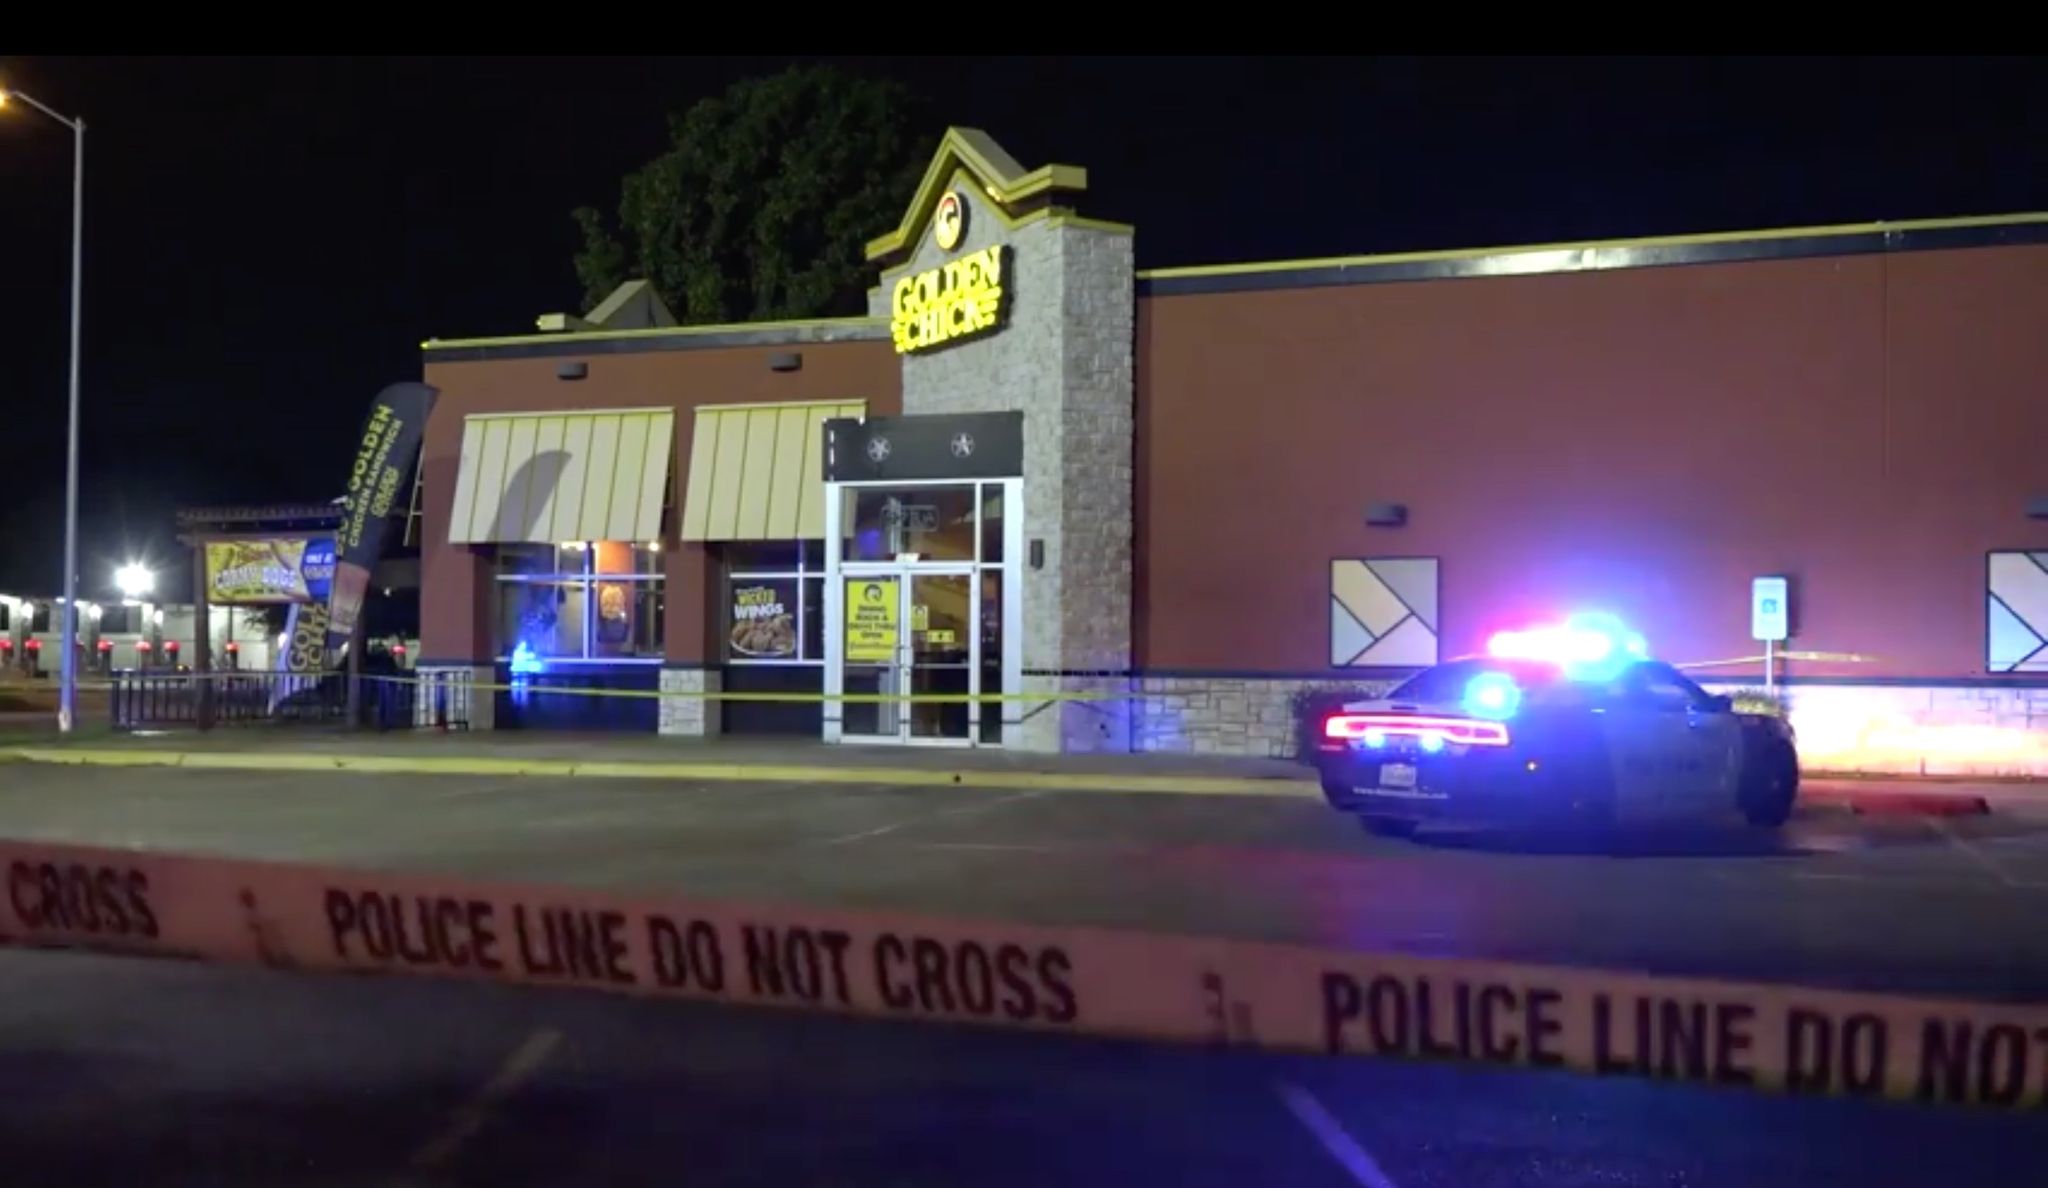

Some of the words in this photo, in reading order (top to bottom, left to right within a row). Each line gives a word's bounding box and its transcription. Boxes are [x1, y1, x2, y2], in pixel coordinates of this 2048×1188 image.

[893, 245, 1000, 319] GOLDEN
[903, 299, 985, 351] CHICK
[348, 403, 394, 491] GOLDEN
[349, 488, 371, 547] CHICKEN
[366, 419, 403, 486] SANDWICH
[734, 603, 784, 619] WINGS
[8, 861, 159, 938] CROSS
[324, 888, 505, 969] POLICE
[513, 904, 636, 984] LINE
[646, 915, 725, 992] DO
[741, 924, 852, 1003] NOT
[873, 933, 1077, 1023] CROSS
[1321, 971, 1565, 1064] POLICE
[1593, 994, 1755, 1085] LINE
[1786, 1007, 1888, 1095] DO
